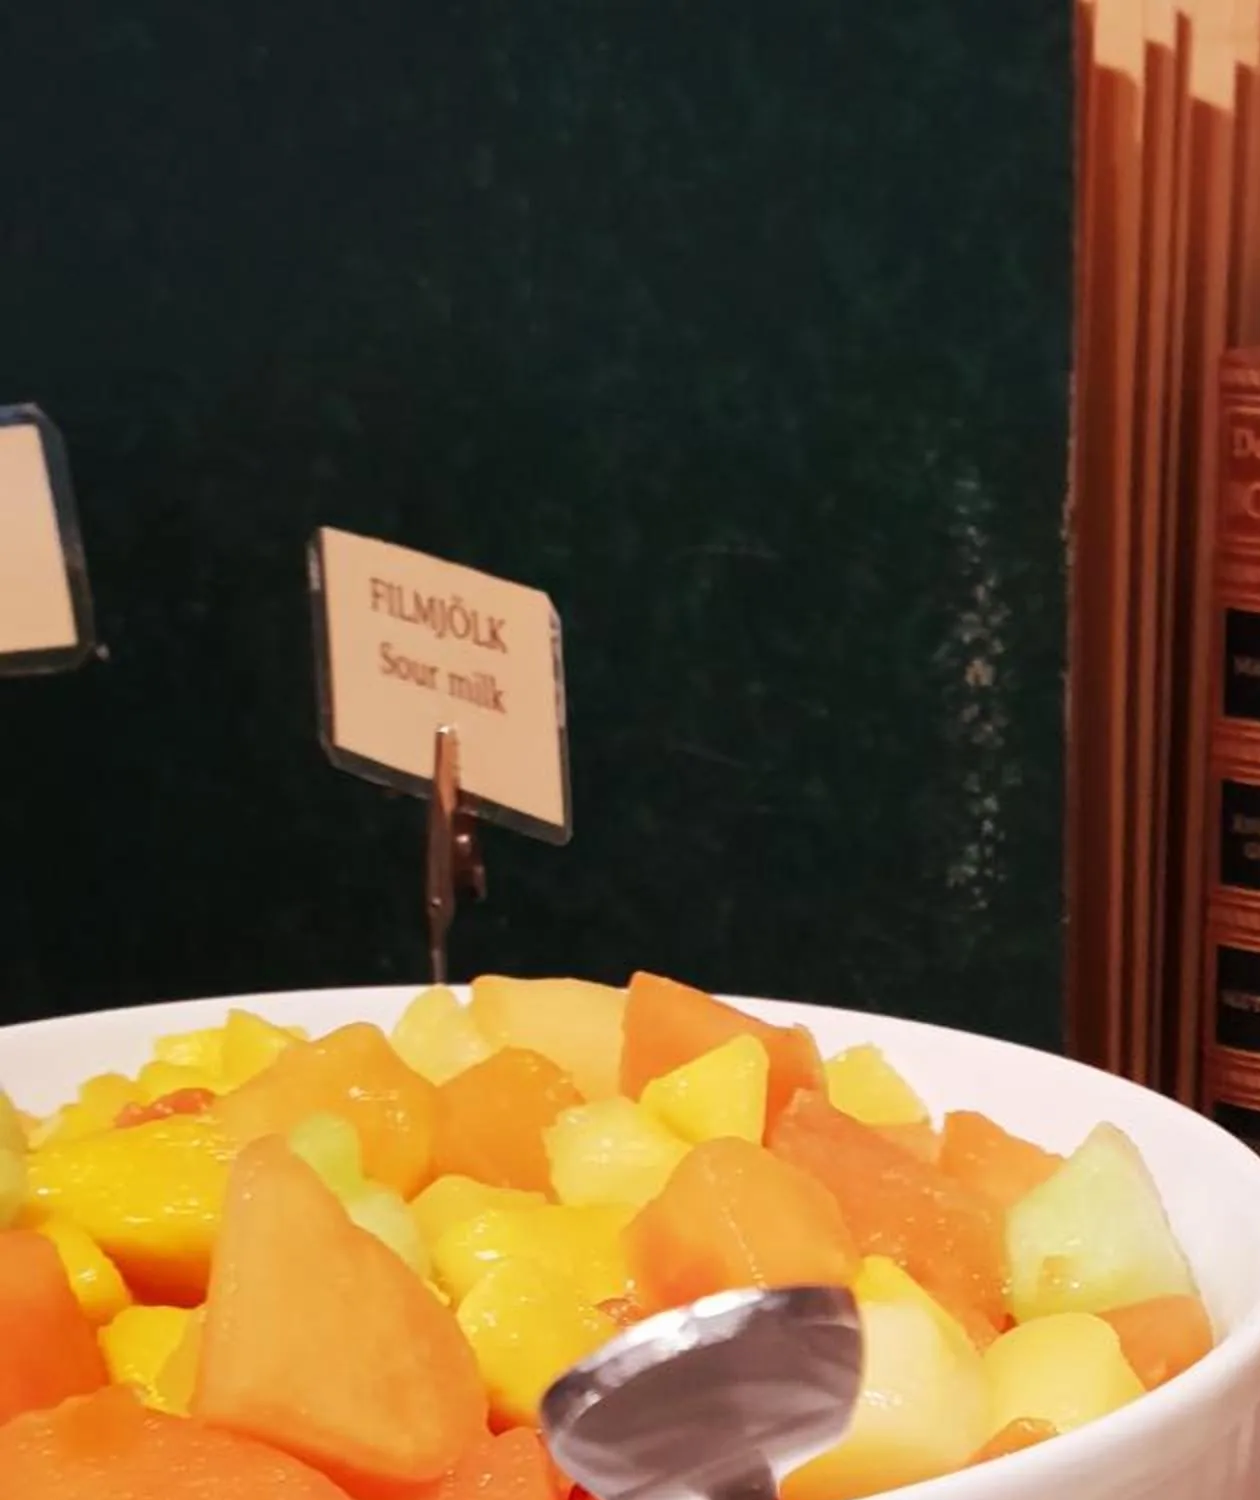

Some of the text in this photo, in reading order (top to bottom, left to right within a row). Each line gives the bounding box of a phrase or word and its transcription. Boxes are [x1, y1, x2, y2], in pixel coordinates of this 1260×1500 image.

[370, 577, 508, 654] FILMJÖLK
[379, 641, 507, 714] Sour milk
